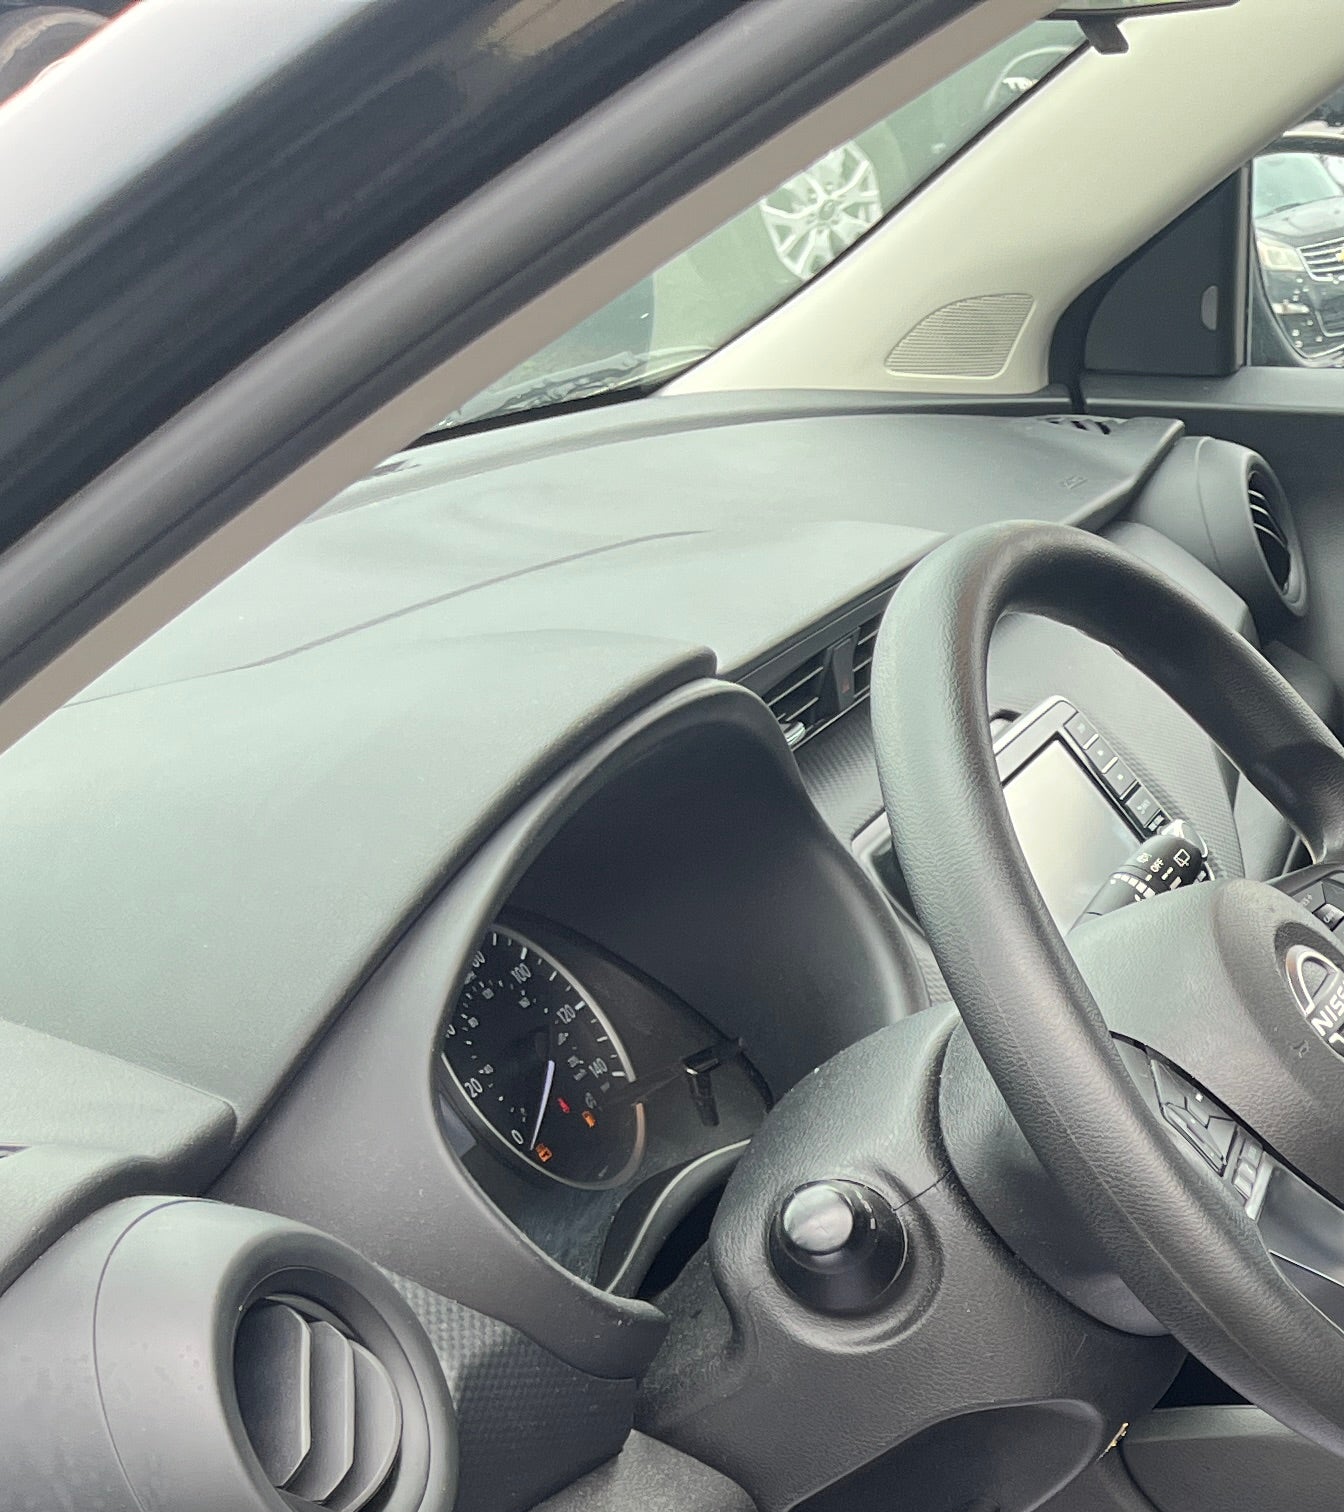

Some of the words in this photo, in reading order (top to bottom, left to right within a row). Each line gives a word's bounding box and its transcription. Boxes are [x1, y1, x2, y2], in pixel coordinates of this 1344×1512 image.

[511, 963, 531, 984] 100
[556, 1004, 576, 1023] 120
[588, 1057, 608, 1079] 140
[464, 1078, 483, 1098] 20
[511, 1129, 524, 1145] 0
